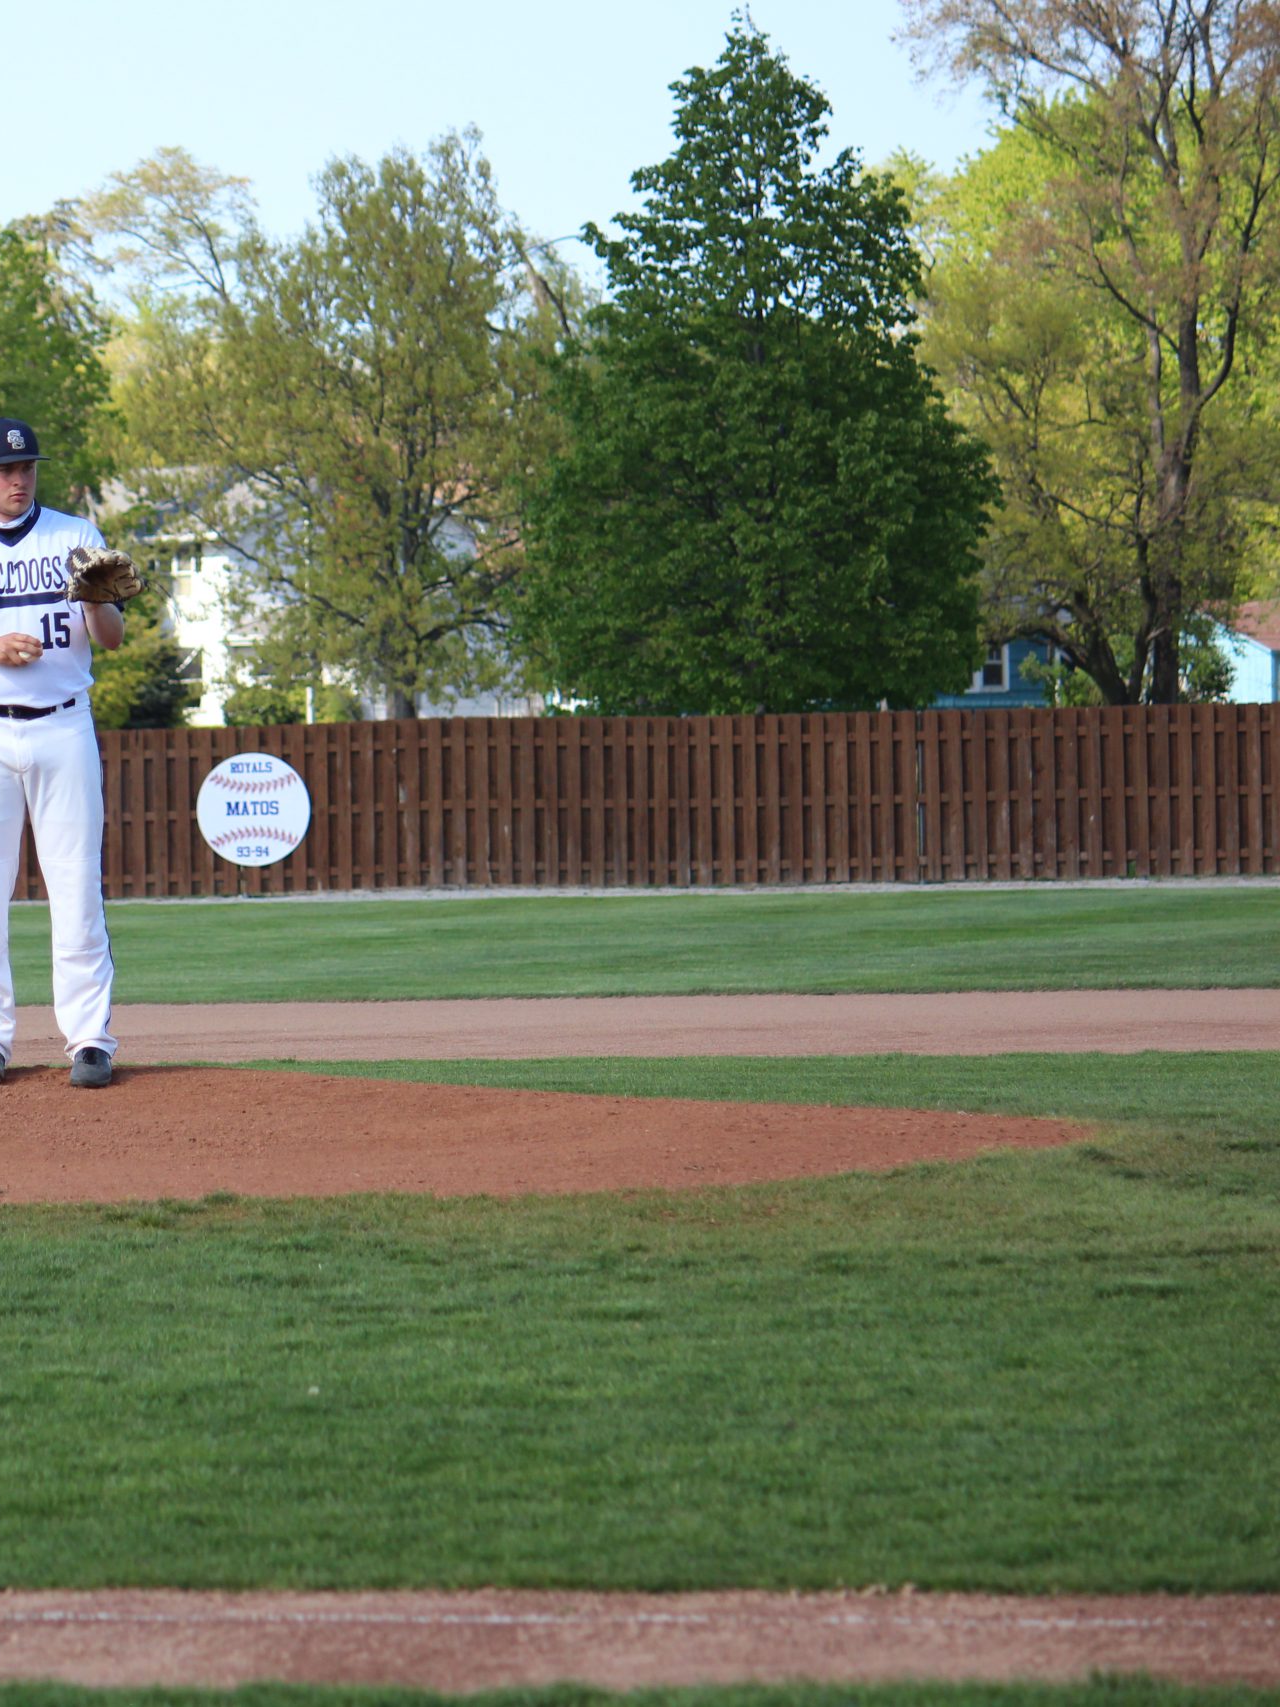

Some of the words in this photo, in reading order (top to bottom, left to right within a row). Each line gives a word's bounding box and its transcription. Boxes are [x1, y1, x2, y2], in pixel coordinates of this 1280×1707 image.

[40, 612, 70, 650] 15
[230, 762, 273, 774] ROYALS
[226, 800, 279, 816] MATOS
[236, 845, 270, 857] 93-94
